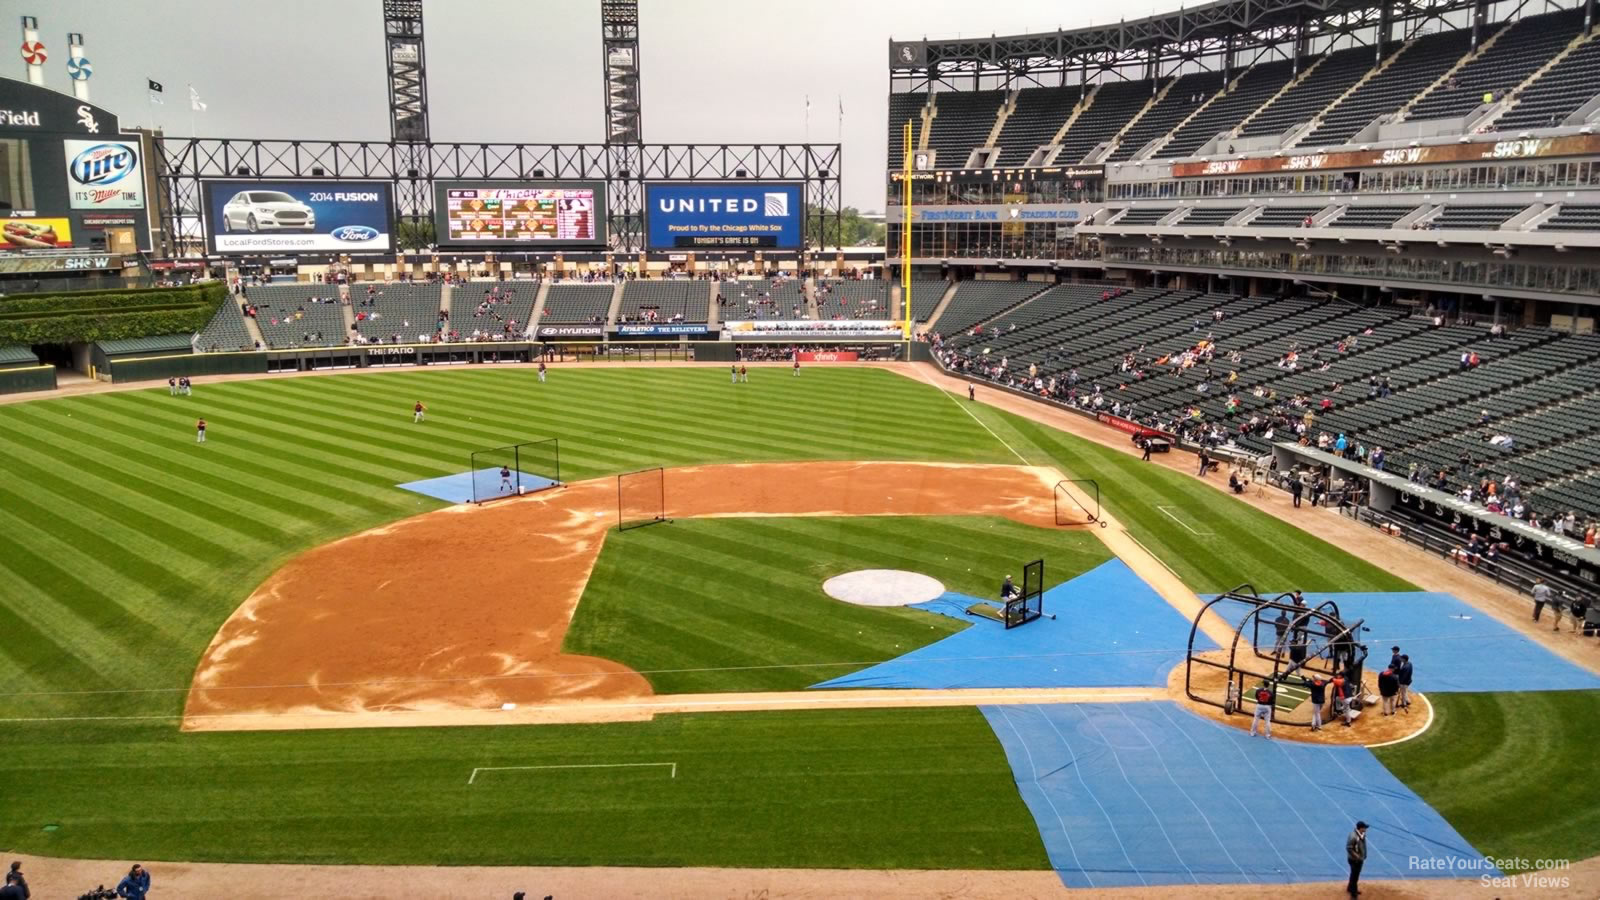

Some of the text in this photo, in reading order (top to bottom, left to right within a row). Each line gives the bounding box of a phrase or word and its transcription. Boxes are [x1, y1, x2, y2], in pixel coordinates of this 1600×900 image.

[0, 110, 40, 126] Field
[77, 105, 99, 133] Sox
[1494, 140, 1540, 157] SHOW
[1290, 156, 1322, 168] SHOW
[1383, 148, 1422, 164] SHOW
[82, 151, 127, 185] Lite
[1210, 162, 1238, 173] SHOW
[76, 189, 136, 204] IT'S Miller TIME
[310, 192, 378, 202] 2014 FUSION
[660, 198, 758, 213] UNITED
[1020, 211, 1057, 219] STADIUM
[1060, 211, 1079, 219] CLUB
[340, 228, 370, 240] Ford
[699, 225, 708, 233] fly
[722, 225, 748, 233] Chicago
[224, 238, 315, 246] LocalFordStores.com
[65, 257, 109, 268] SHOW
